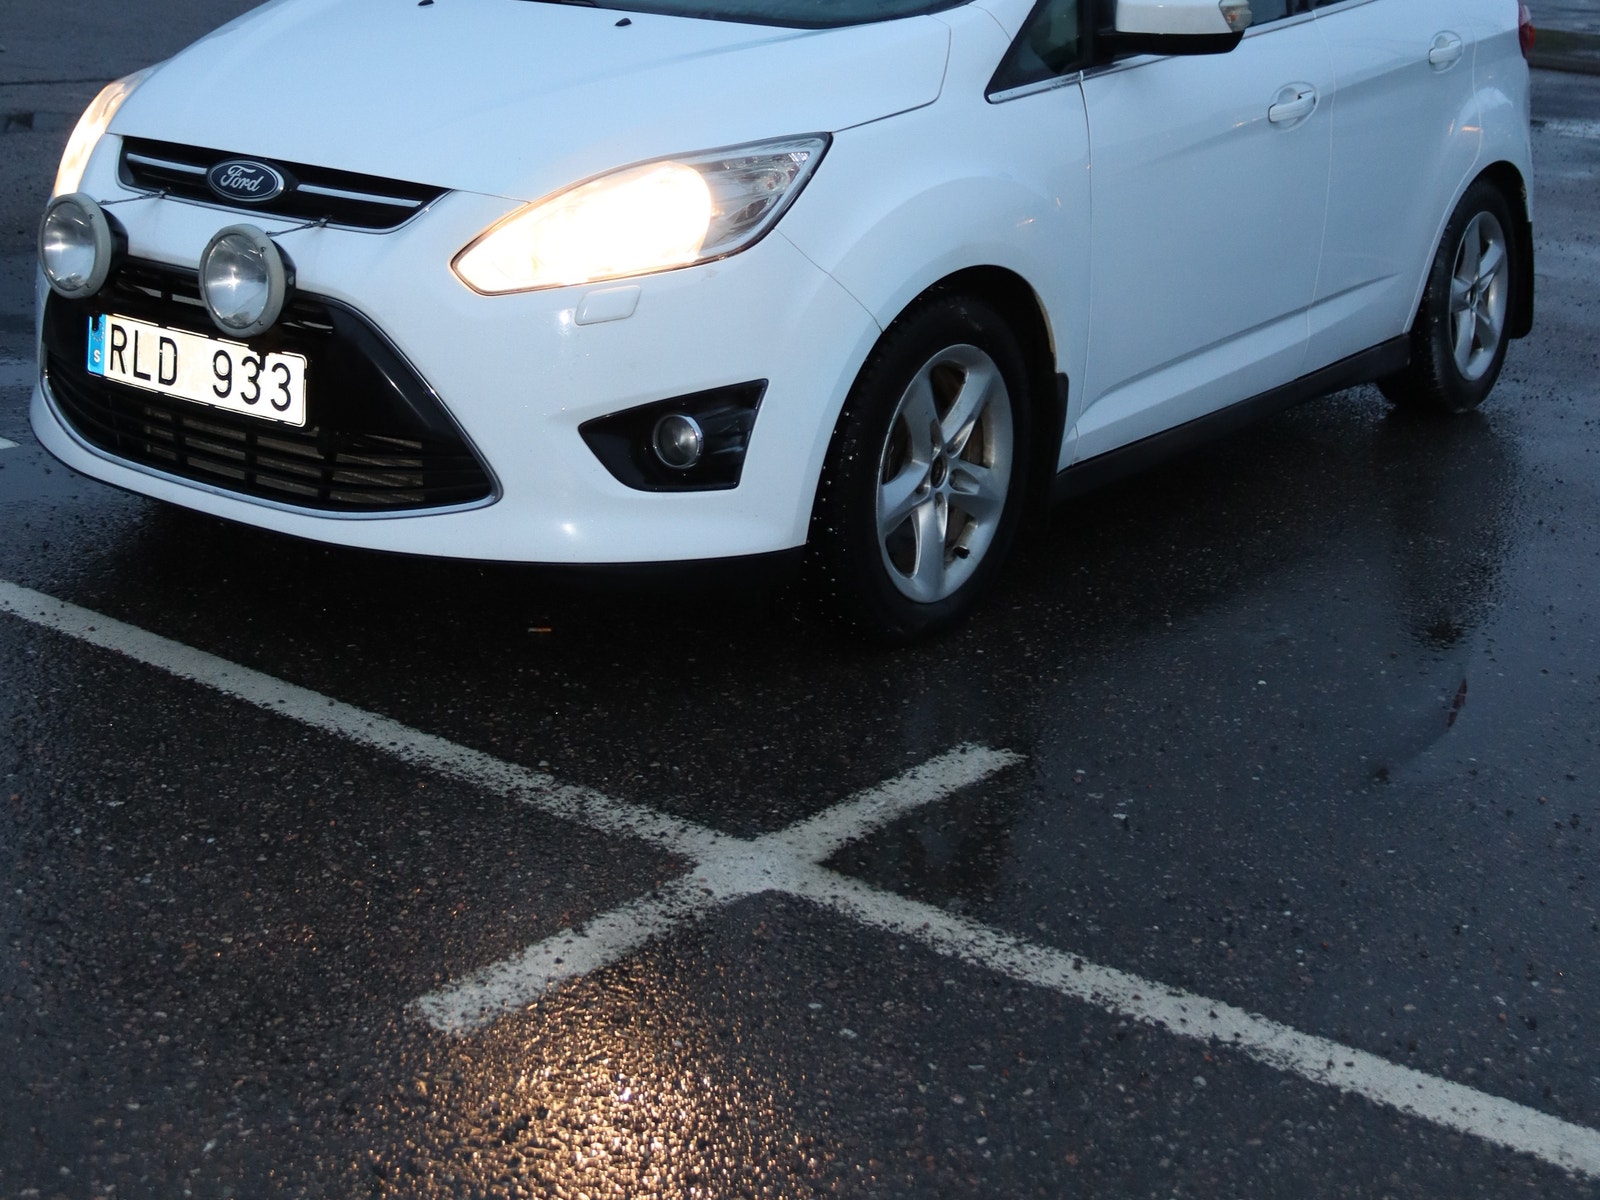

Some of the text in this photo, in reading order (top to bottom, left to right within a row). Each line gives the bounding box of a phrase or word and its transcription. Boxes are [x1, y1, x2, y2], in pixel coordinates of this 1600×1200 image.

[221, 165, 264, 191] Ford
[93, 323, 291, 412] S RLD 933
